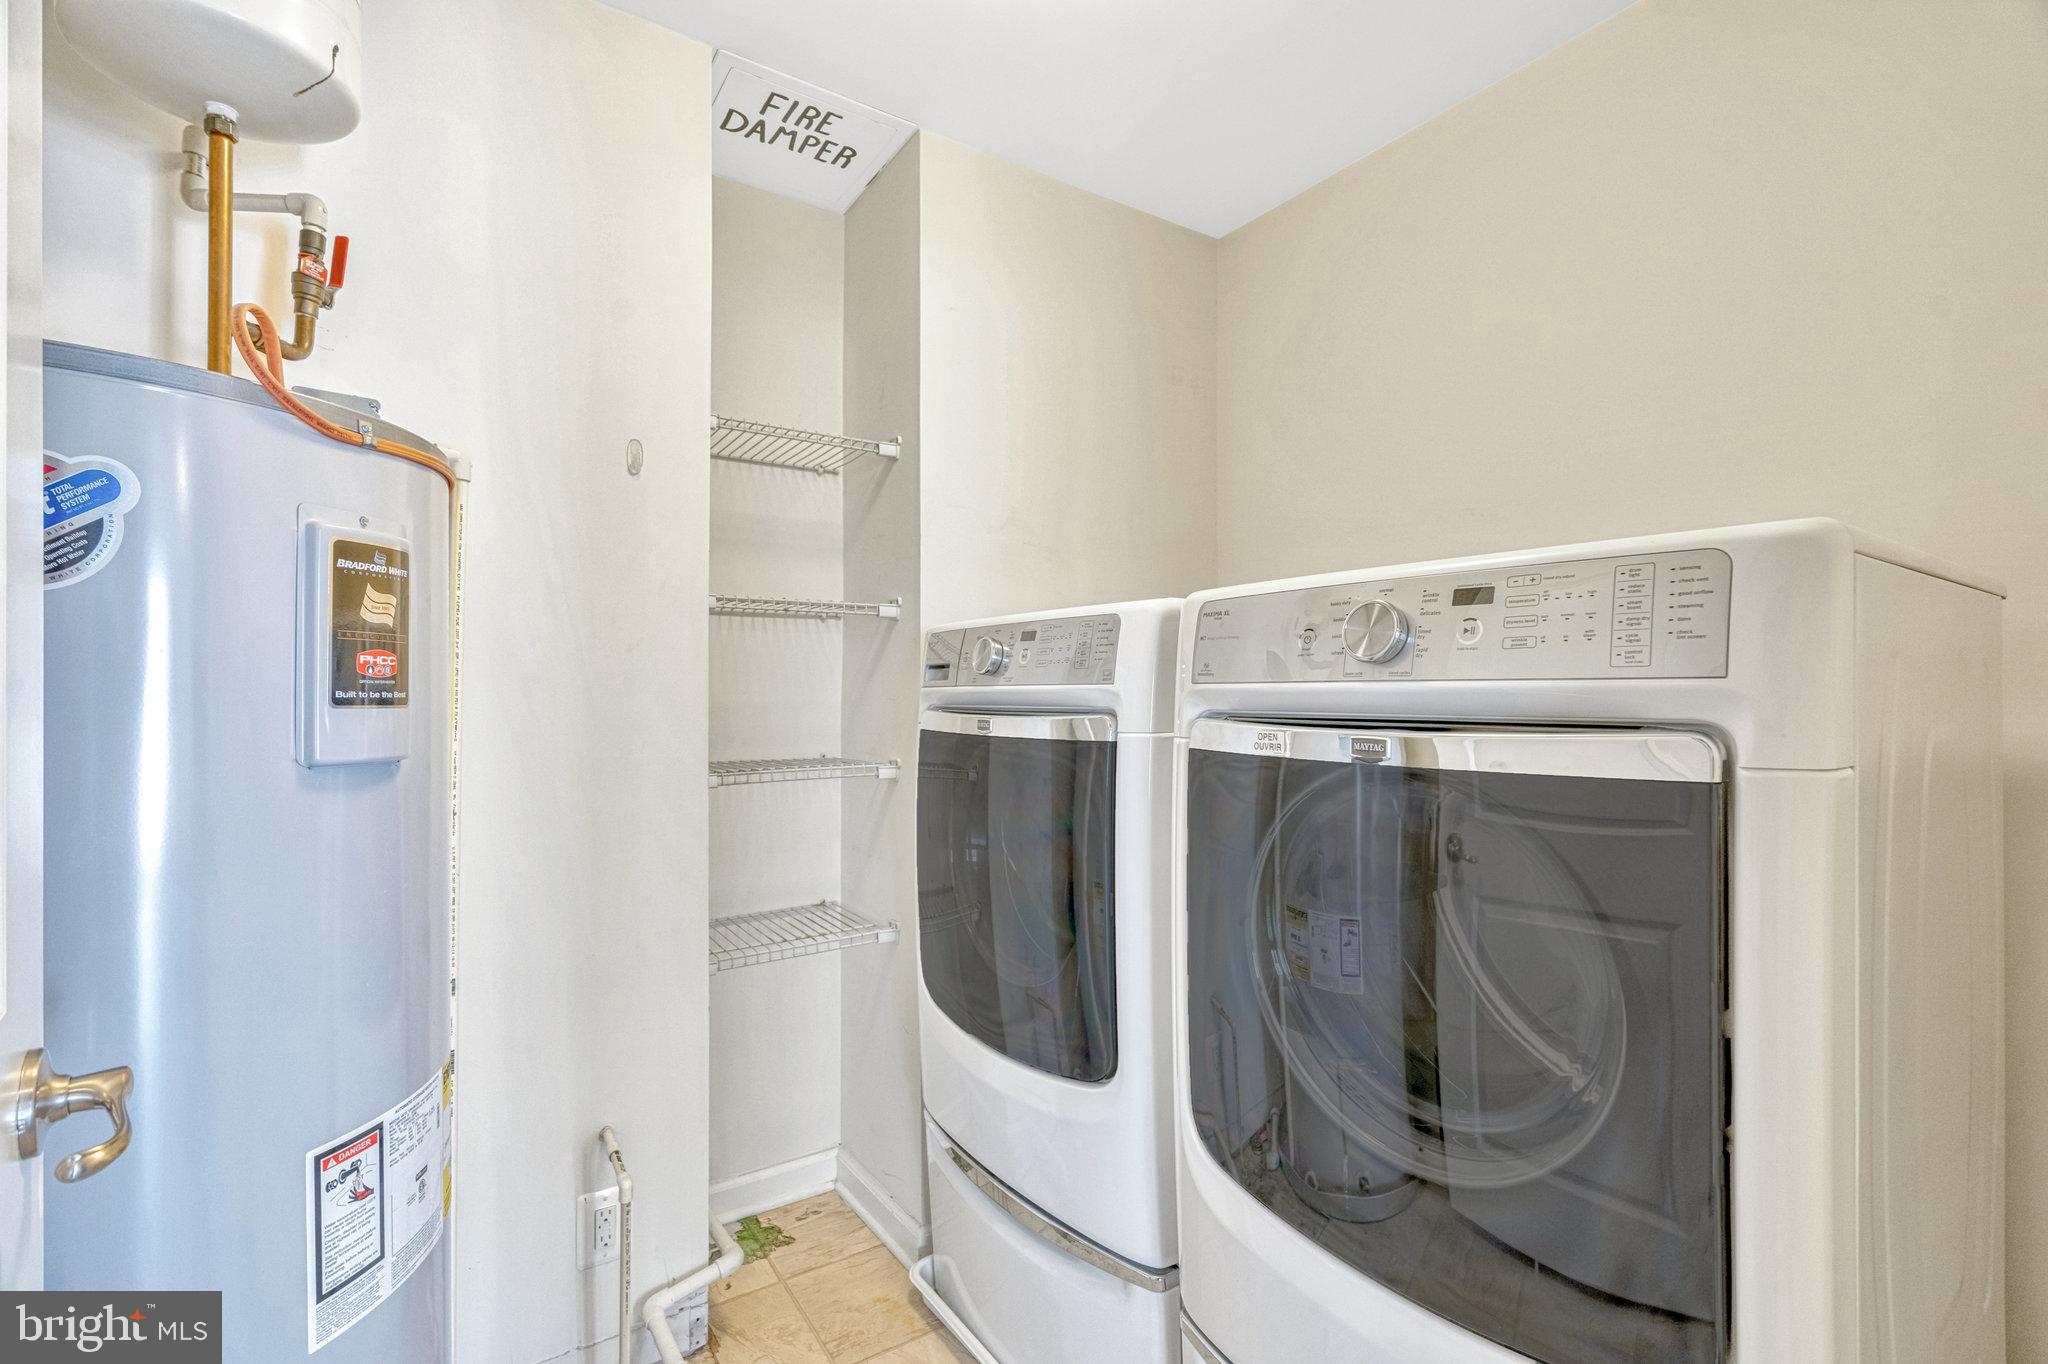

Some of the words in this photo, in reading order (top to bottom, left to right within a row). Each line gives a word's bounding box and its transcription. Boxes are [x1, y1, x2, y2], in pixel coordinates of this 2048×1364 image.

[759, 91, 844, 136] FIRE
[719, 108, 857, 169] DAMPER
[50, 482, 74, 496] TOTAL
[56, 477, 110, 503] PERFORMANCE
[60, 493, 91, 511] SYSTEM
[43, 538, 66, 552] ediment
[64, 529, 88, 542] Buildup
[49, 567, 82, 581] WHITE
[85, 513, 115, 567] CORPORATION
[44, 546, 74, 562] Operating
[71, 539, 89, 549] Costs
[67, 549, 85, 560] Water
[336, 558, 387, 574] BRADFORD
[388, 566, 408, 578] WHITE
[359, 655, 396, 665] PHCC
[335, 690, 357, 699] Built
[1254, 742, 1282, 751] OUVRIR
[1257, 733, 1278, 741] OPEN
[1353, 742, 1384, 752] MAYTAG
[338, 1138, 372, 1162] DANGER
